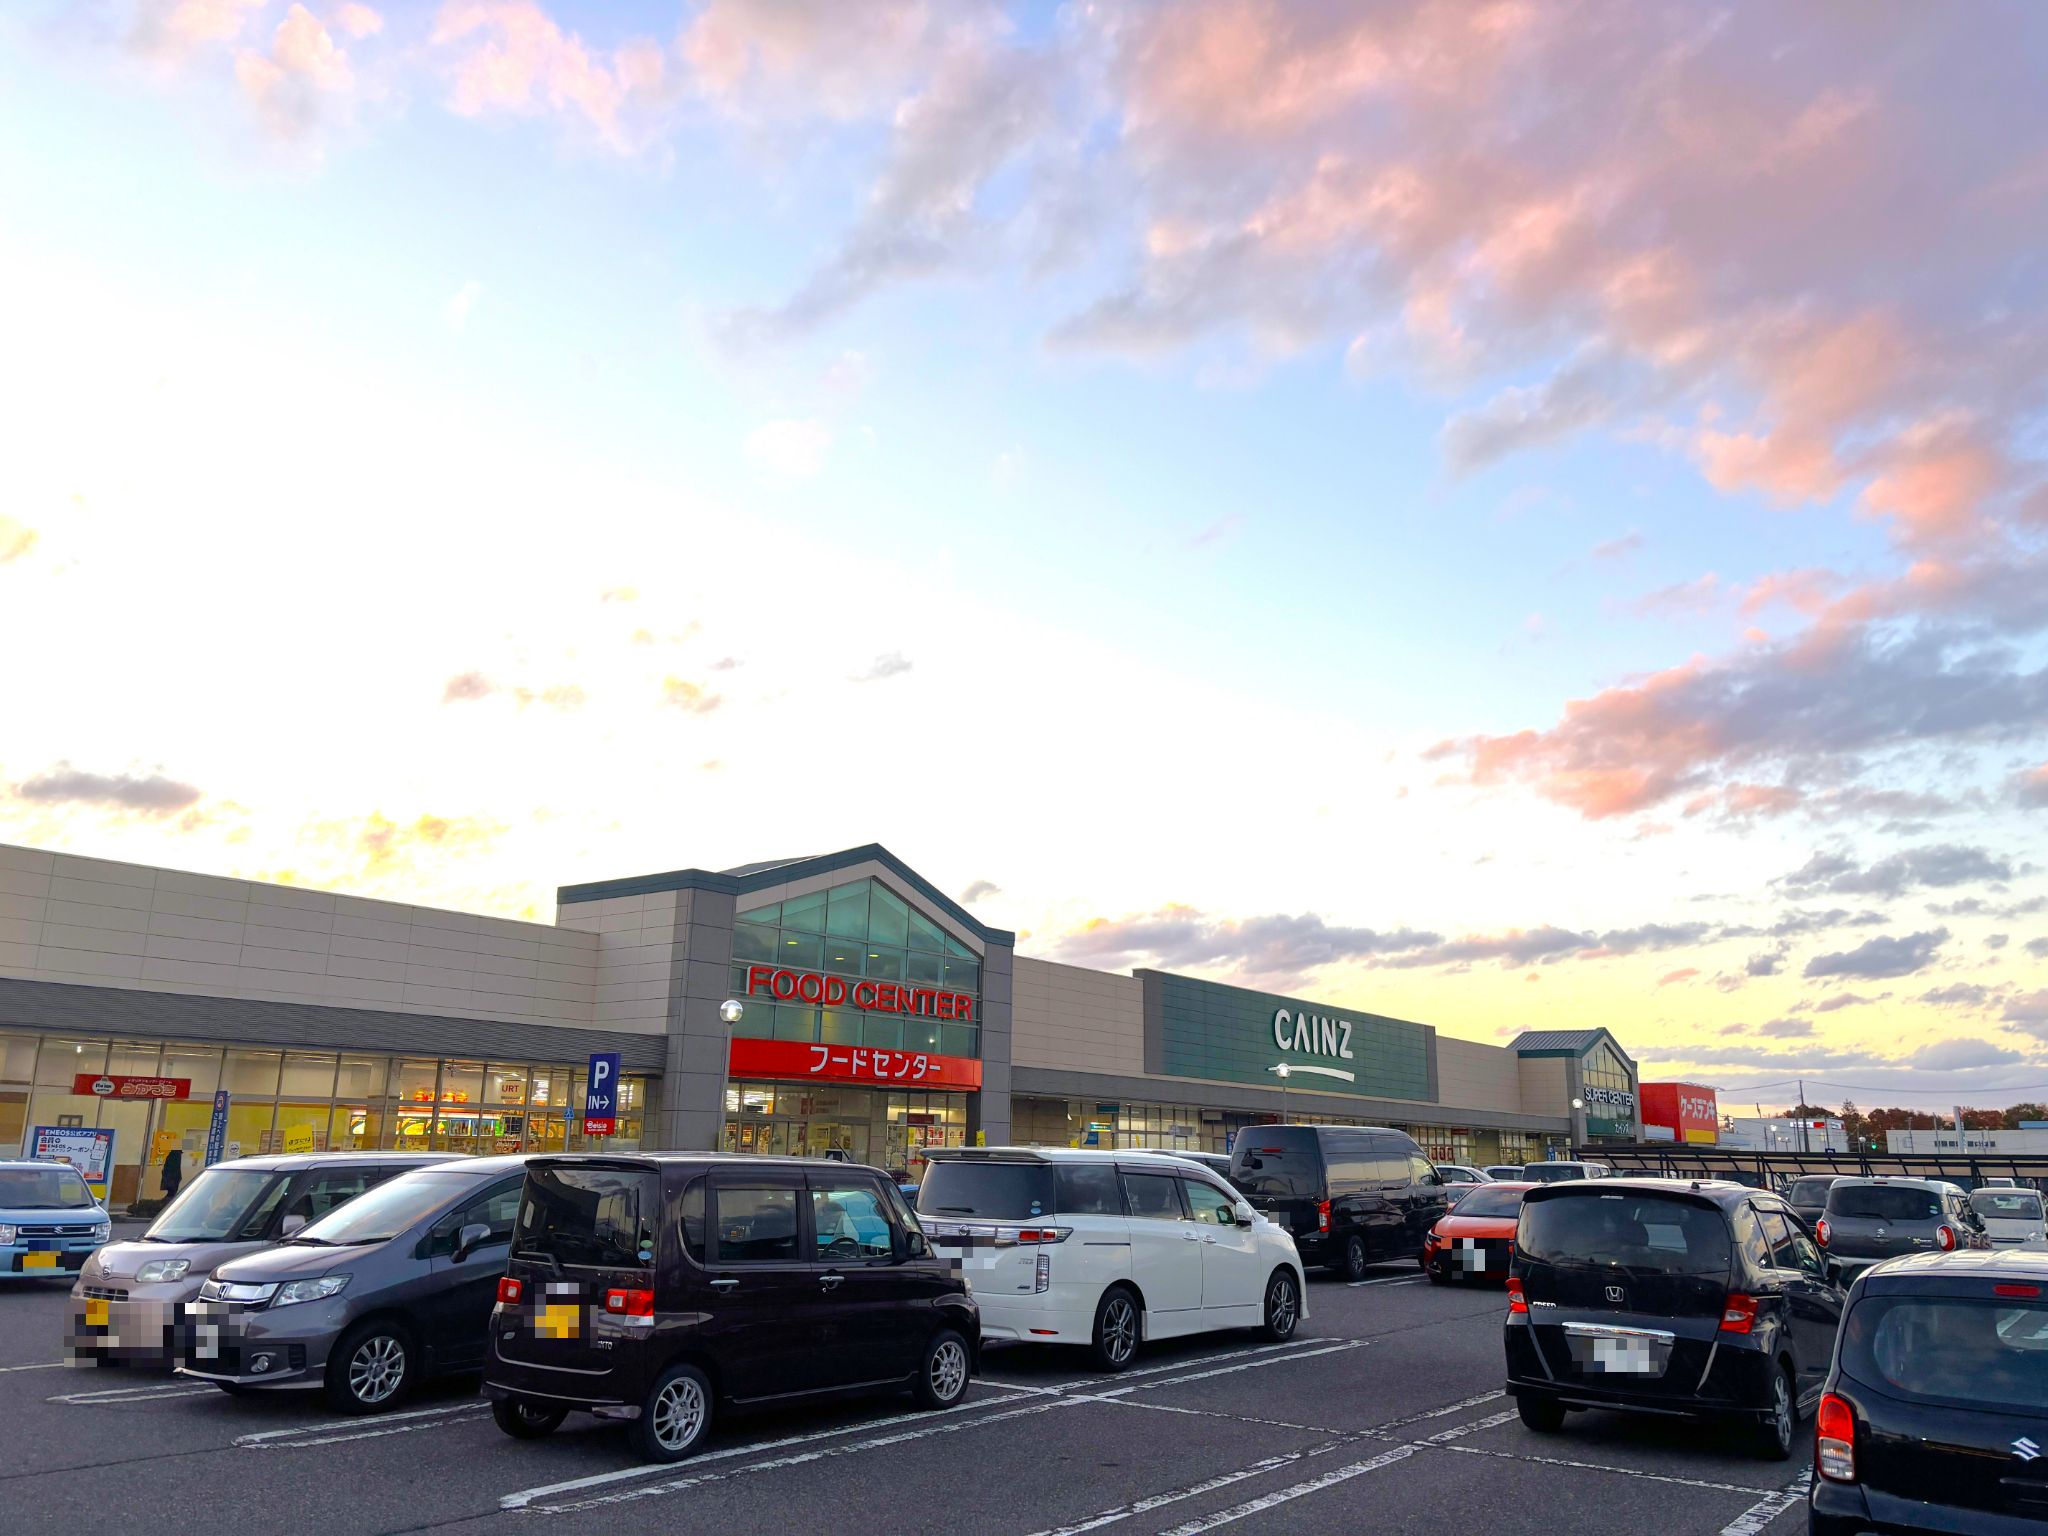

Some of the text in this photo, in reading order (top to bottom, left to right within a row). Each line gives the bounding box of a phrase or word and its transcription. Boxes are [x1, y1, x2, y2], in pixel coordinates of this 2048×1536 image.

[746, 965, 973, 1022] FOOD CENTER
[1274, 1008, 1354, 1059] CAINZ
[593, 1061, 610, 1089] P
[810, 1046, 941, 1079] フードセンター
[120, 1082, 177, 1097] みかづき
[587, 1095, 600, 1110] IN
[1584, 1087, 1634, 1107] SUPER CENTER
